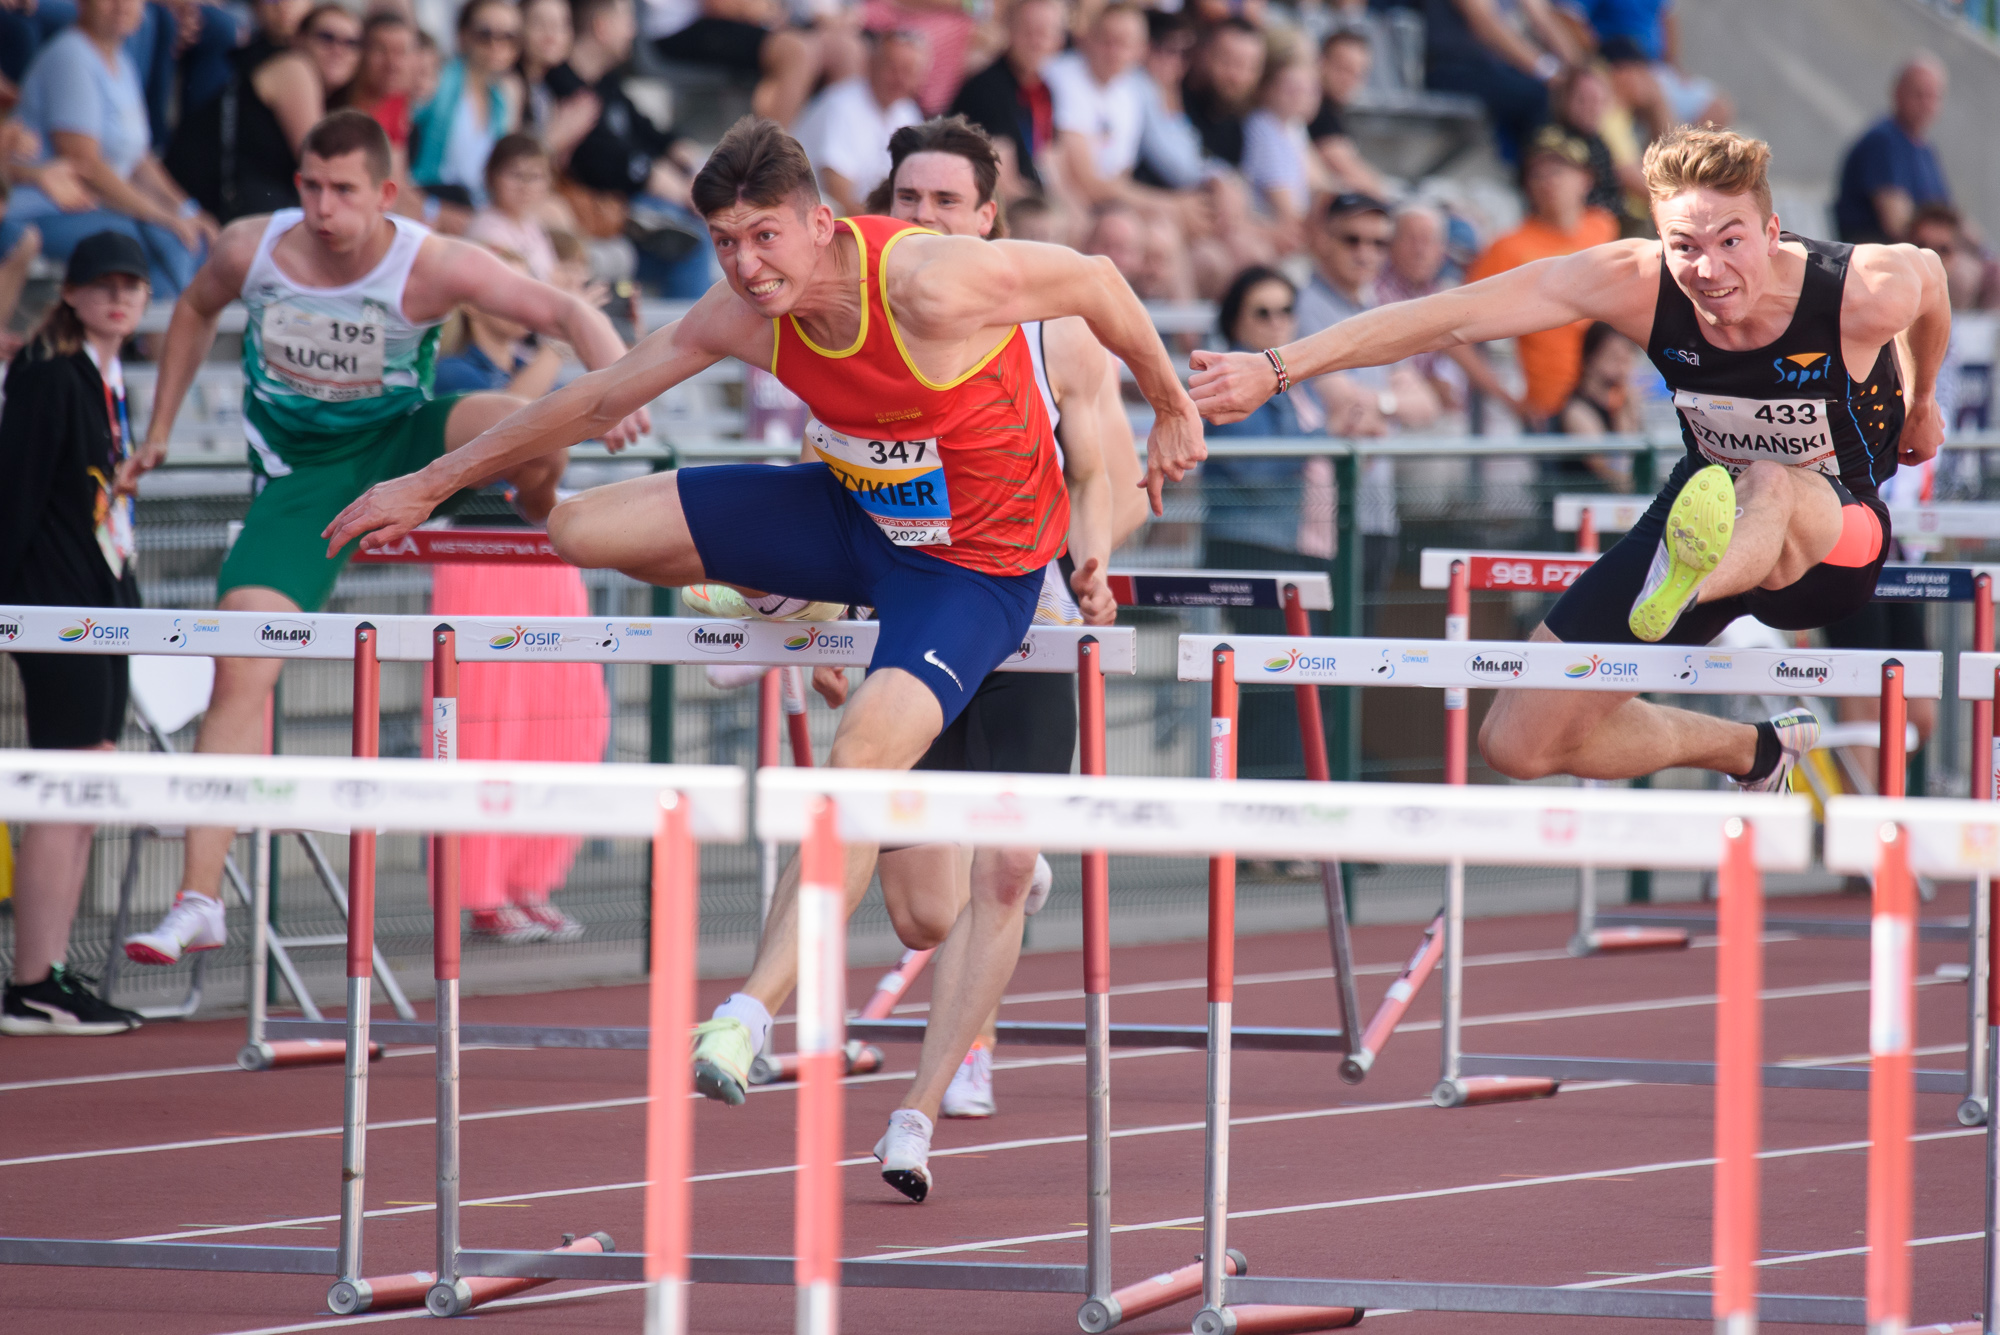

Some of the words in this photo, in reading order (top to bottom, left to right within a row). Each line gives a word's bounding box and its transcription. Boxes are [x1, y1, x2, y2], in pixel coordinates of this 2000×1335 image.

[329, 321, 376, 345] 195
[284, 345, 358, 374] ŁUCKI
[1773, 355, 1831, 389] Sopot
[1754, 403, 1818, 425] 433
[1691, 419, 1827, 456] SZYMAŃSKI
[867, 441, 926, 465] 347
[890, 530, 927, 542] 2022
[93, 626, 129, 639] OSIR
[524, 632, 562, 646] OSIR
[626, 628, 653, 636] SUWAŁKI
[817, 635, 854, 648] OSIR
[1298, 657, 1337, 670] OSIR
[1599, 662, 1638, 676] OSIR
[435, 728, 448, 765] anik
